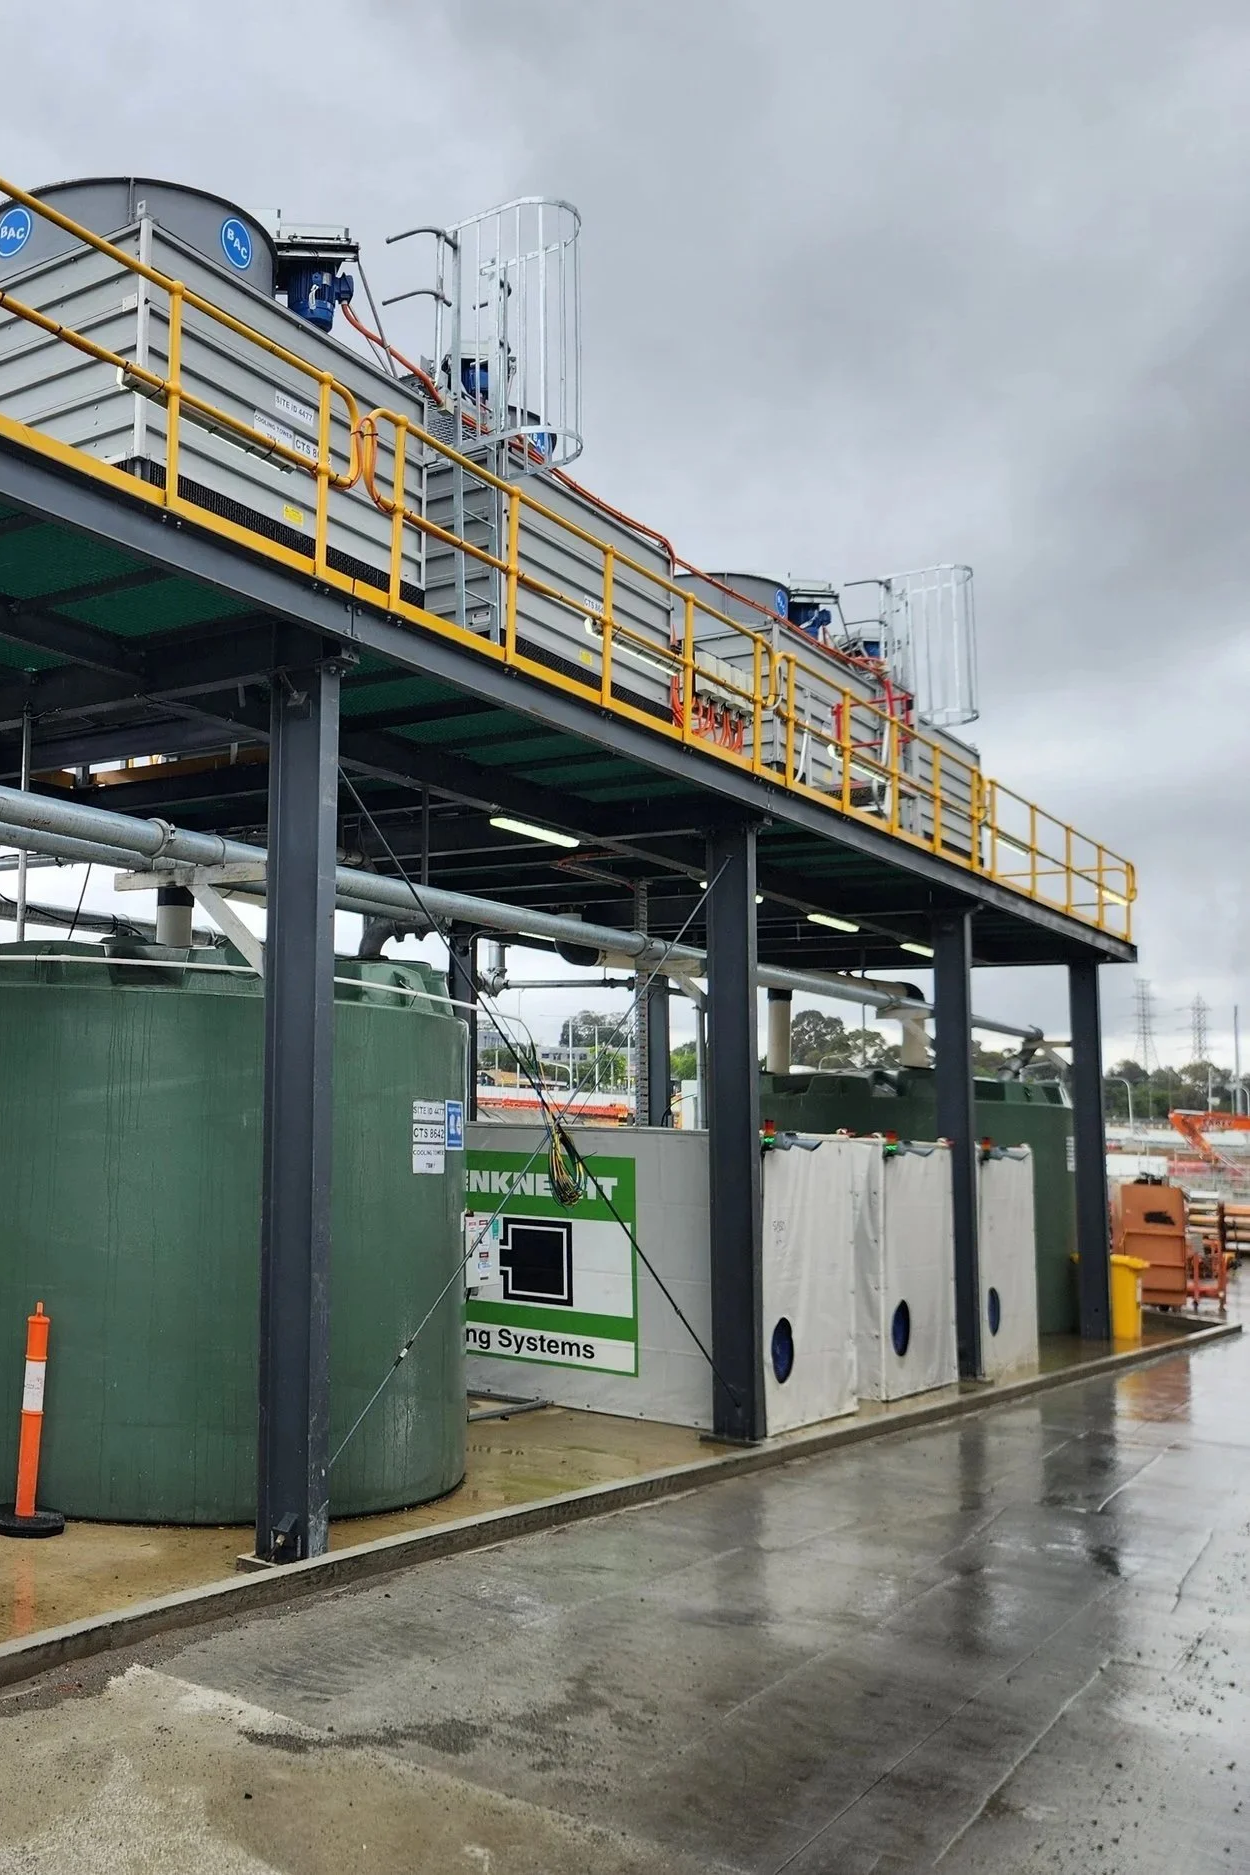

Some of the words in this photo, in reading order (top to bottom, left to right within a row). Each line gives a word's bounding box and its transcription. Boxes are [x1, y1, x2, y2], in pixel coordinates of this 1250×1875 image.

[0, 226, 25, 240] BAC
[227, 227, 248, 260] BAC
[276, 396, 290, 409] SITE
[291, 403, 297, 413] ID
[255, 414, 275, 430] COOLING
[277, 427, 292, 438] TOWER
[296, 440, 311, 454] CTS
[413, 1106, 426, 1114] SITE
[414, 1128, 428, 1137] CTS
[430, 1129, 444, 1138] 8642
[498, 1328, 595, 1359] Systems
